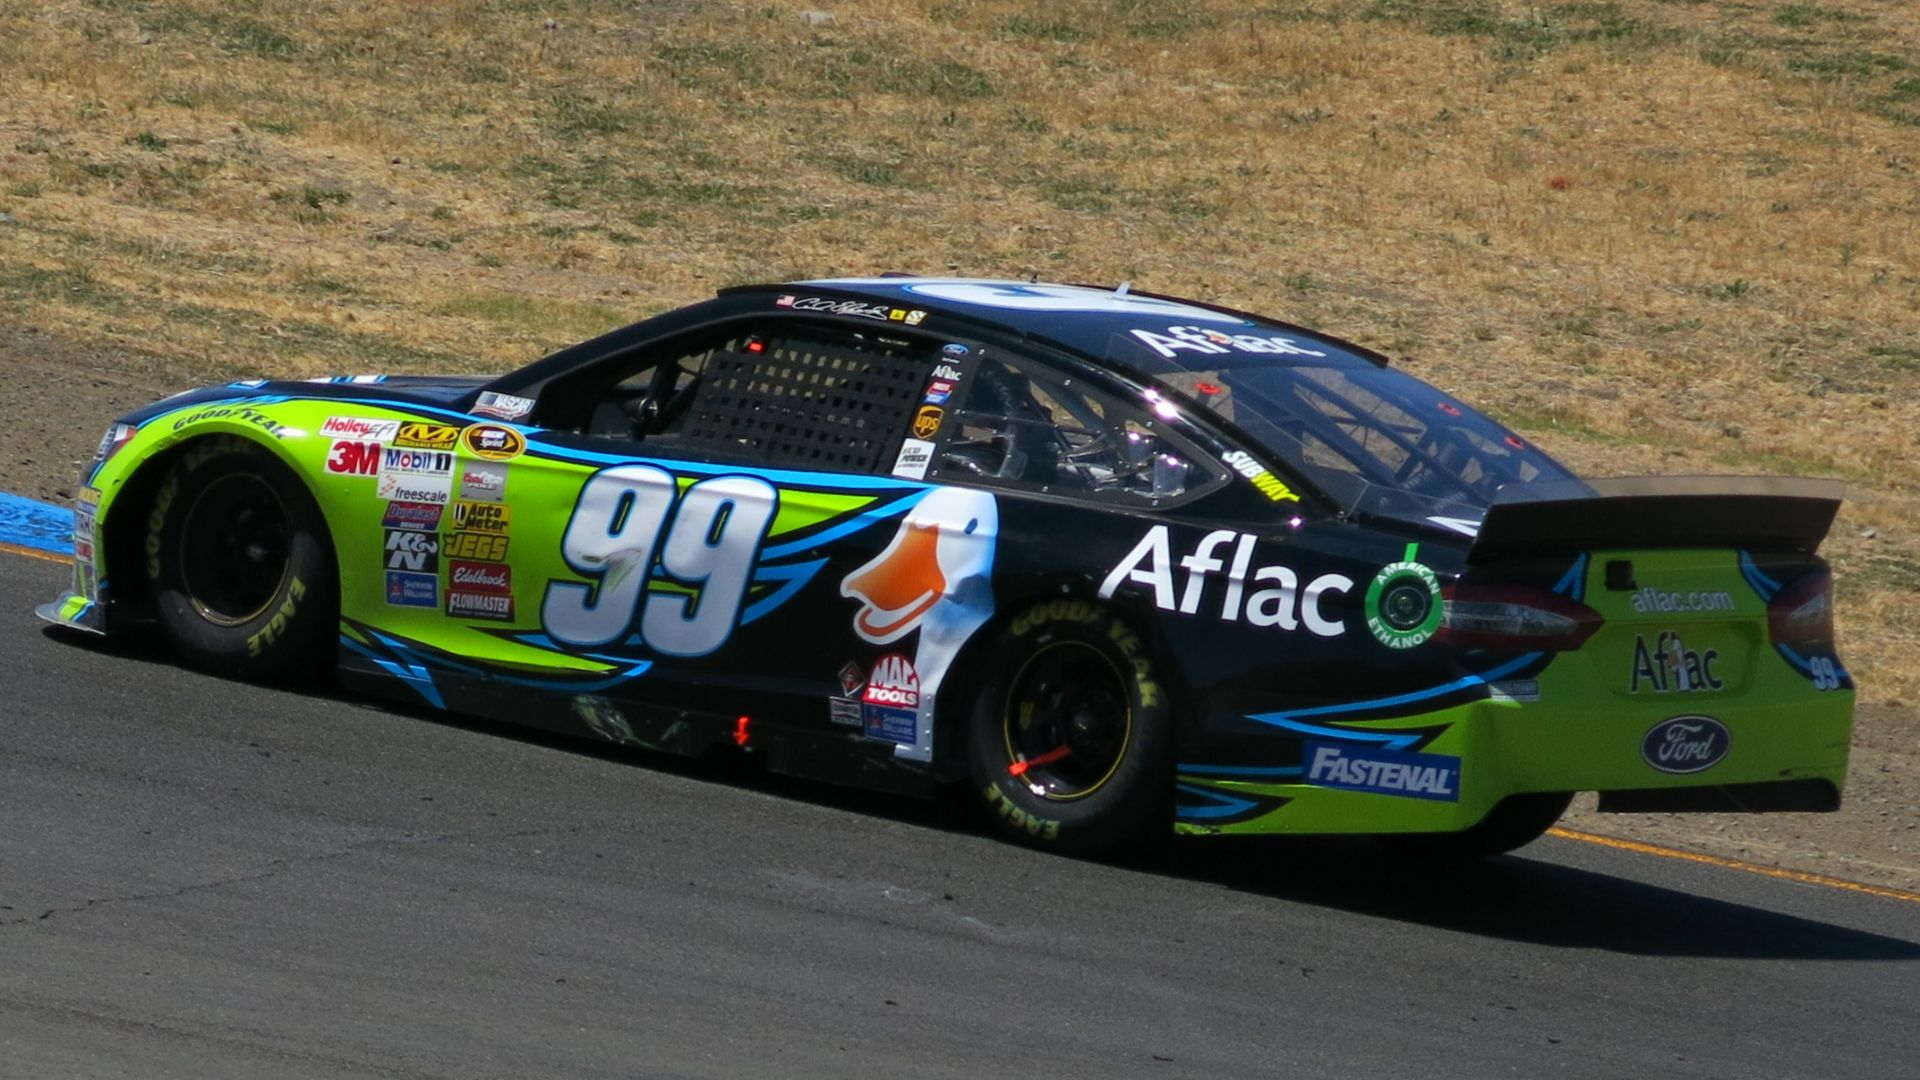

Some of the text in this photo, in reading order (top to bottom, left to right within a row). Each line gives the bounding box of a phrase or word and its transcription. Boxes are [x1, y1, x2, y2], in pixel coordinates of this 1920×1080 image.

[324, 417, 370, 438] Holley
[328, 441, 381, 475] 3M
[385, 449, 432, 469] Mobil
[1222, 450, 1301, 502] SUBWAY
[394, 486, 447, 502] freescale
[469, 503, 502, 518] Auto
[465, 515, 508, 530] Meter
[443, 533, 508, 561] JEGS
[541, 463, 779, 659] 99
[453, 567, 507, 587] Edelbrock
[1098, 525, 1355, 637] Aflac
[1376, 561, 1440, 595] AMERICAN
[449, 593, 510, 614] FLOWMASTER
[1632, 587, 1735, 612] aflac.com
[247, 576, 306, 658] EAGLE
[1368, 617, 1433, 649] ETHANOL
[869, 656, 918, 693] MAC
[1810, 656, 1841, 691] 99
[868, 687, 918, 706] TOOLS
[1658, 723, 1716, 761] Ford
[1309, 747, 1452, 795] FASTENAL
[985, 782, 1062, 840] EAGLE
